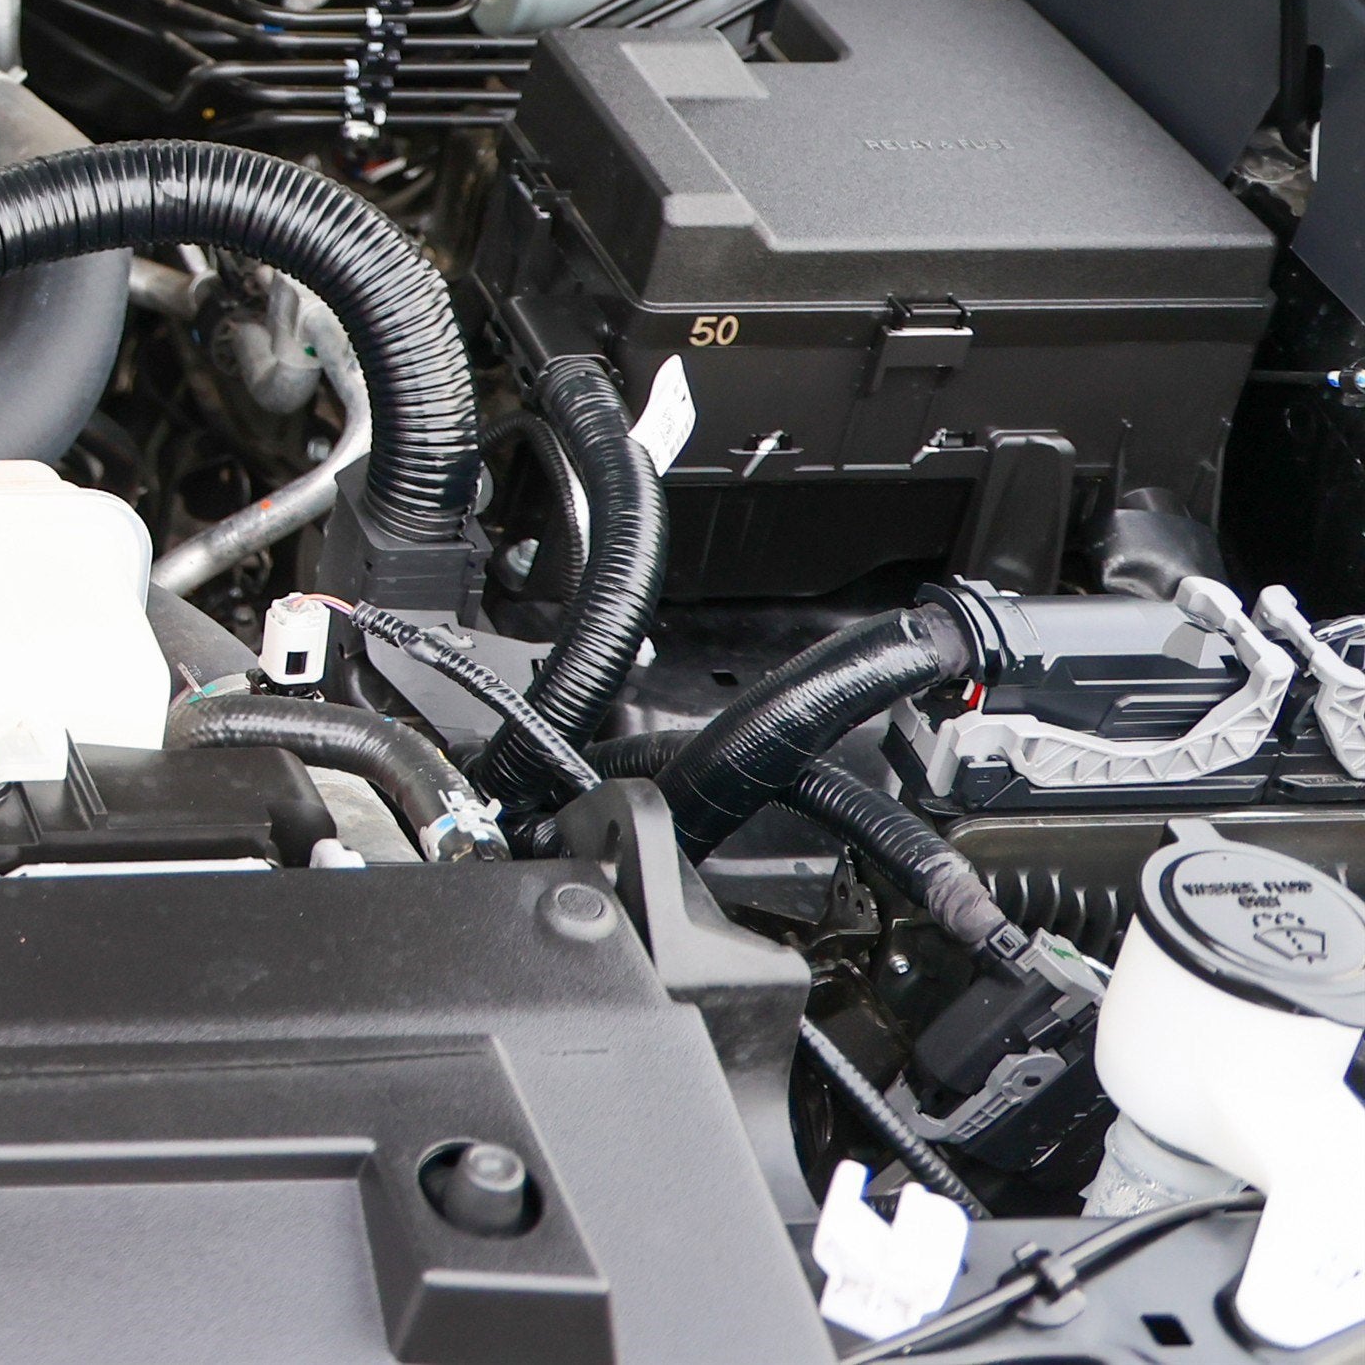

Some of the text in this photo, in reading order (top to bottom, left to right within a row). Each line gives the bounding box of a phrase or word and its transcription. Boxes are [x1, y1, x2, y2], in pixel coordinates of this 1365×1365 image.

[862, 139, 933, 151] RELAY
[957, 138, 1015, 151] FUSE
[688, 314, 740, 347] 50
